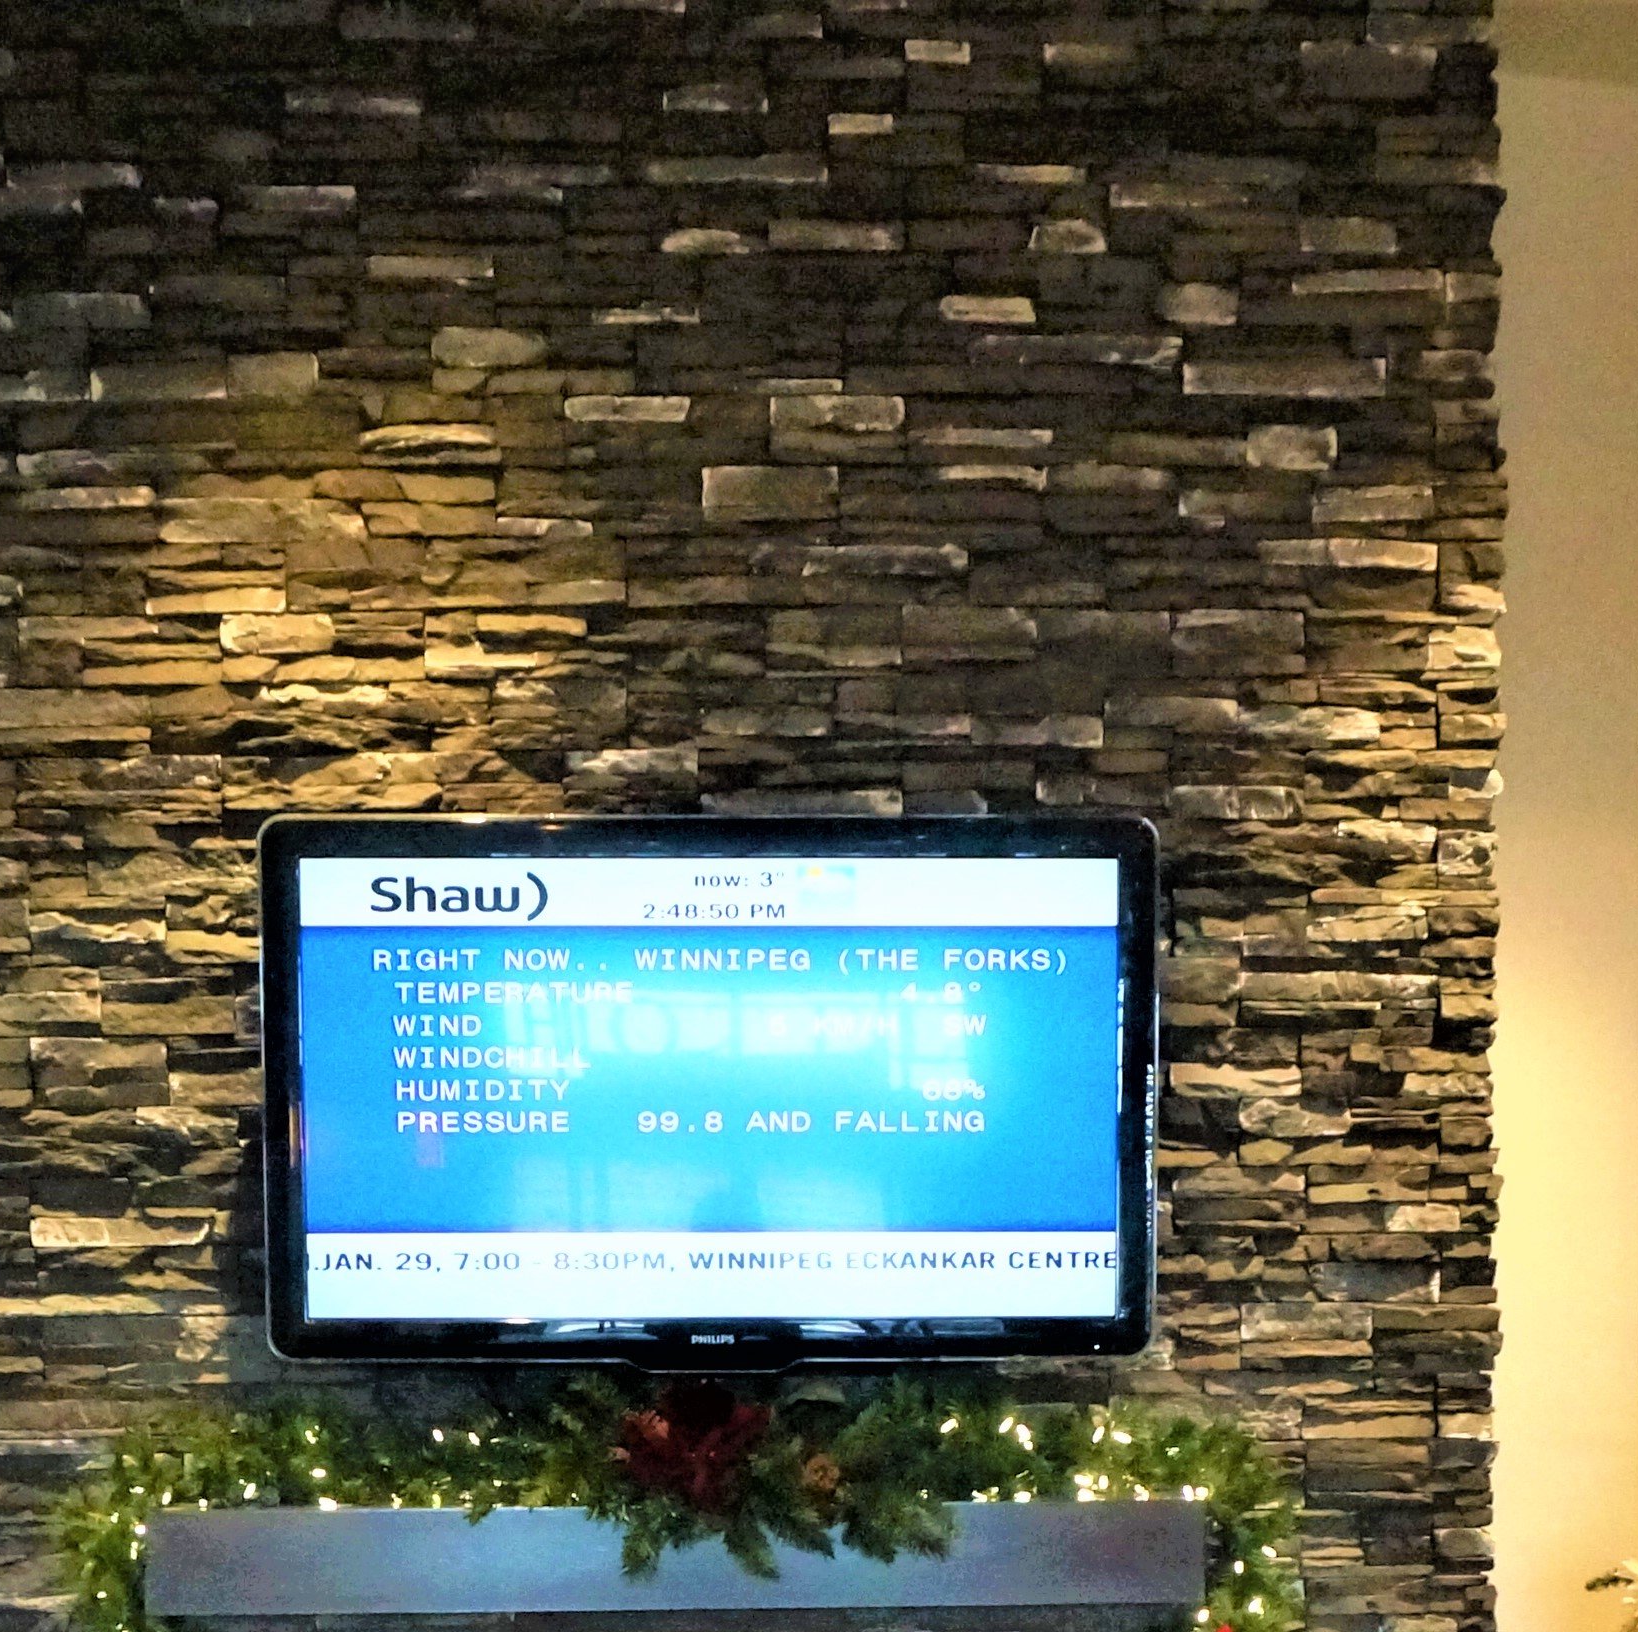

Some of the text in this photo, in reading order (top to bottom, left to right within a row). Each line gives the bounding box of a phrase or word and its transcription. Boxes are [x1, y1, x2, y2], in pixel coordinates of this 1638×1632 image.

[694, 875, 749, 888] now:
[642, 903, 786, 919] 2:48:50 PM
[372, 948, 481, 972] RIGHT
[634, 948, 811, 971] WINNIPEG
[838, 948, 919, 975] (THE
[943, 948, 1067, 975] FORKS)
[394, 981, 633, 1005] TEMPERATURE
[393, 1014, 482, 1037] WIND
[393, 1046, 591, 1069] WINDCHILL
[396, 1079, 570, 1102] HUMIDITY
[397, 1110, 986, 1134] PRESSURE 99.8 AND FALLING
[396, 1252, 441, 1273] 29,
[454, 1252, 520, 1271] 7:00
[554, 1252, 675, 1273] 8:30PM,
[688, 1252, 833, 1270] WINNIPEG
[845, 1251, 996, 1270] ECKANKAR
[1009, 1251, 1117, 1269] CENTRE
[691, 1334, 736, 1345] PHILIPS
